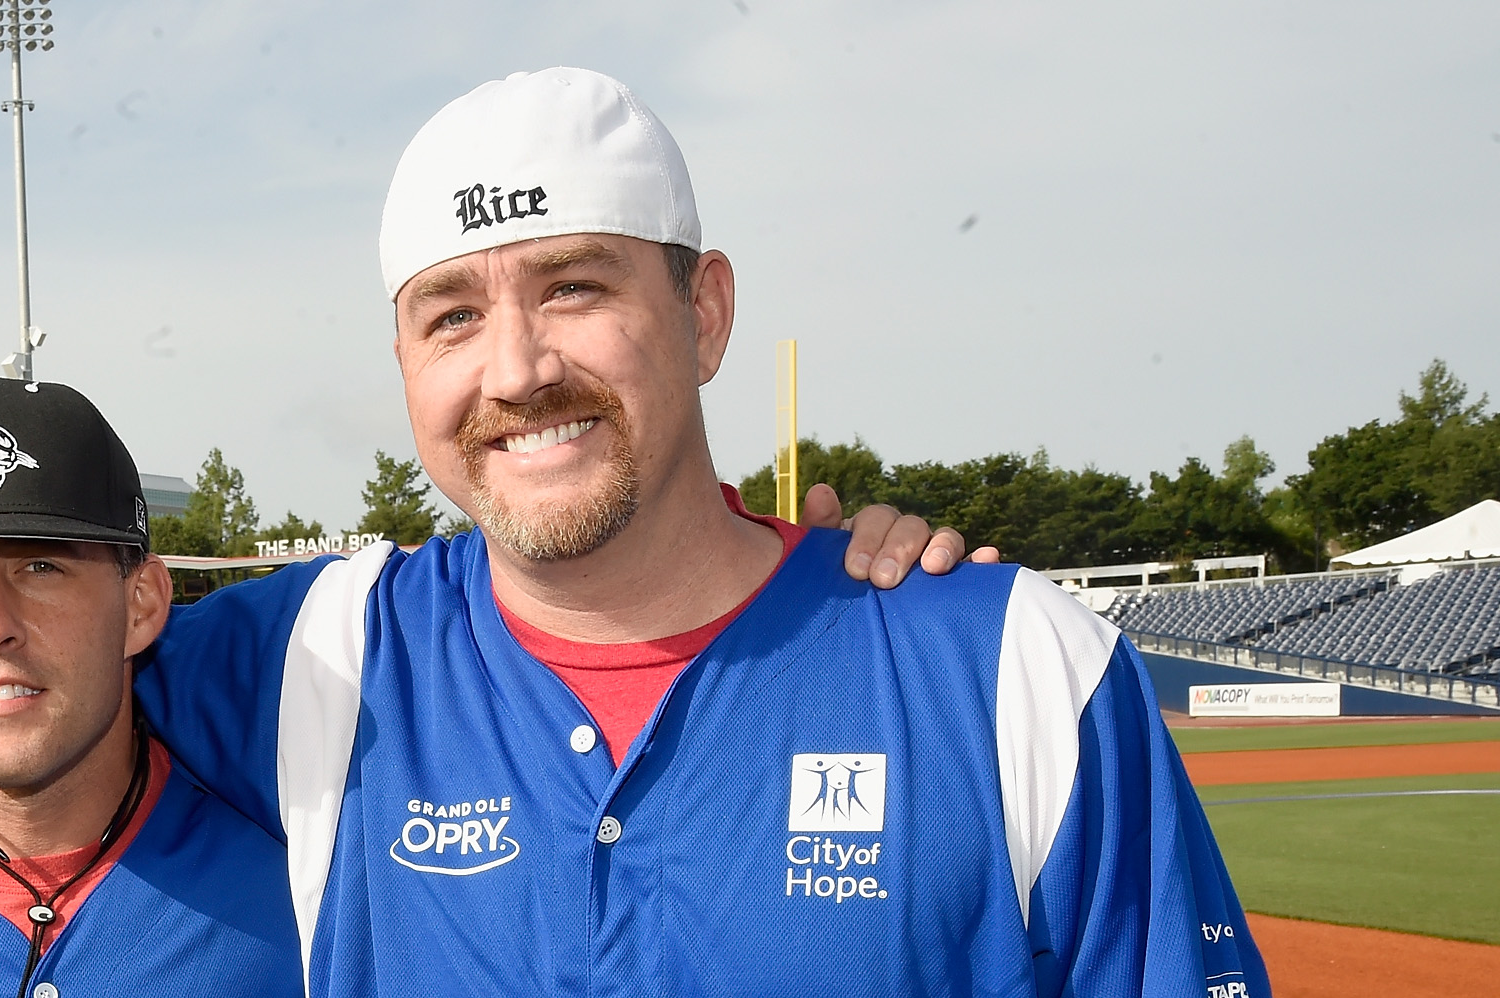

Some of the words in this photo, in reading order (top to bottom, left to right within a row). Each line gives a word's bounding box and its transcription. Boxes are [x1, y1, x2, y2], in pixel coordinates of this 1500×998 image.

[454, 183, 548, 235] Rice
[255, 539, 289, 558] THE
[294, 536, 343, 555] BAND
[1194, 688, 1250, 704] NOVACOPY
[407, 799, 472, 818] GRAND
[474, 796, 511, 814] OLE
[786, 836, 856, 871] City
[854, 843, 881, 865] of
